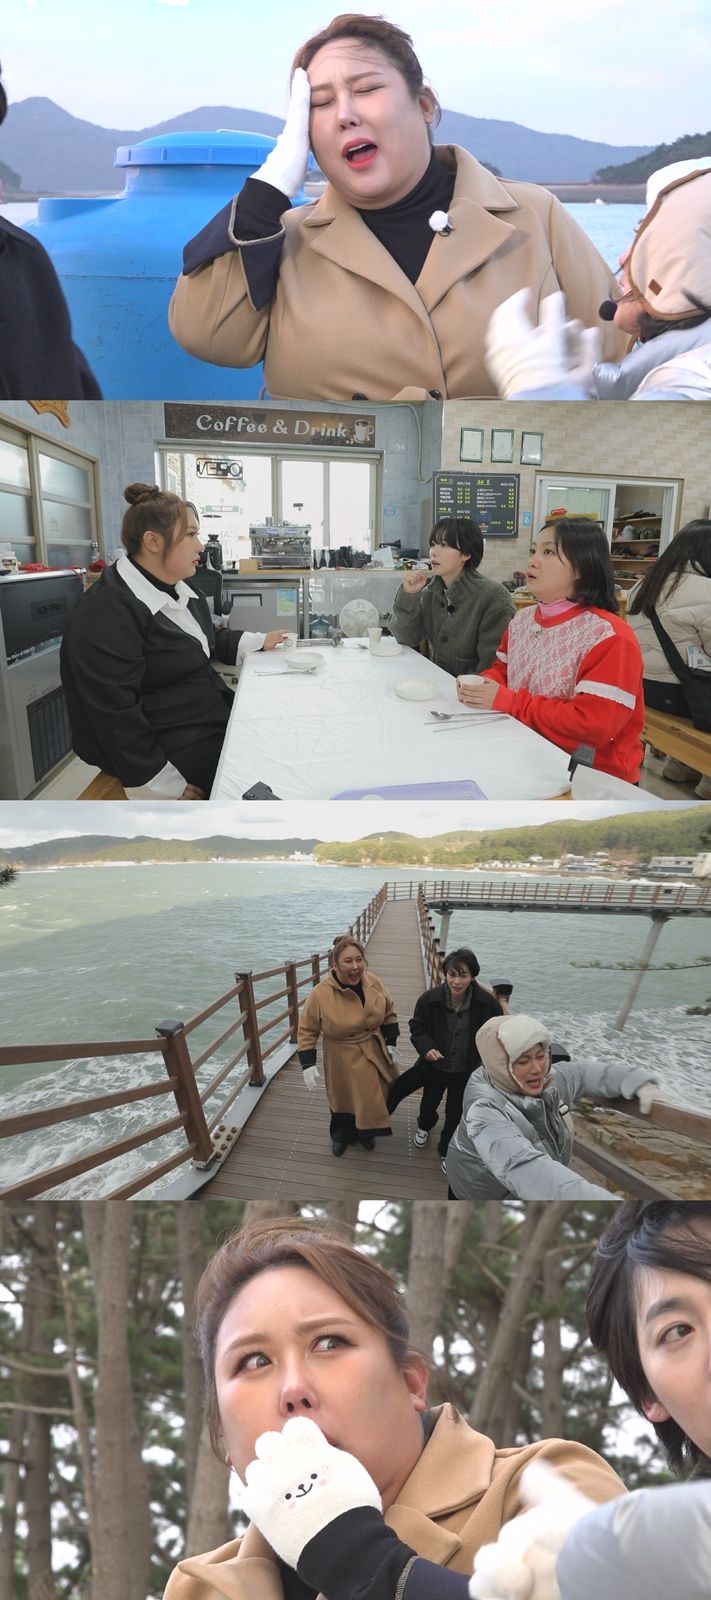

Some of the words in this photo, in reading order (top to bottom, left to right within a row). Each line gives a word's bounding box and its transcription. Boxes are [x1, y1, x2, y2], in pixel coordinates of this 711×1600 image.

[196, 414, 268, 434] Coffee
[272, 418, 288, 435] &
[294, 419, 347, 437] Drink
